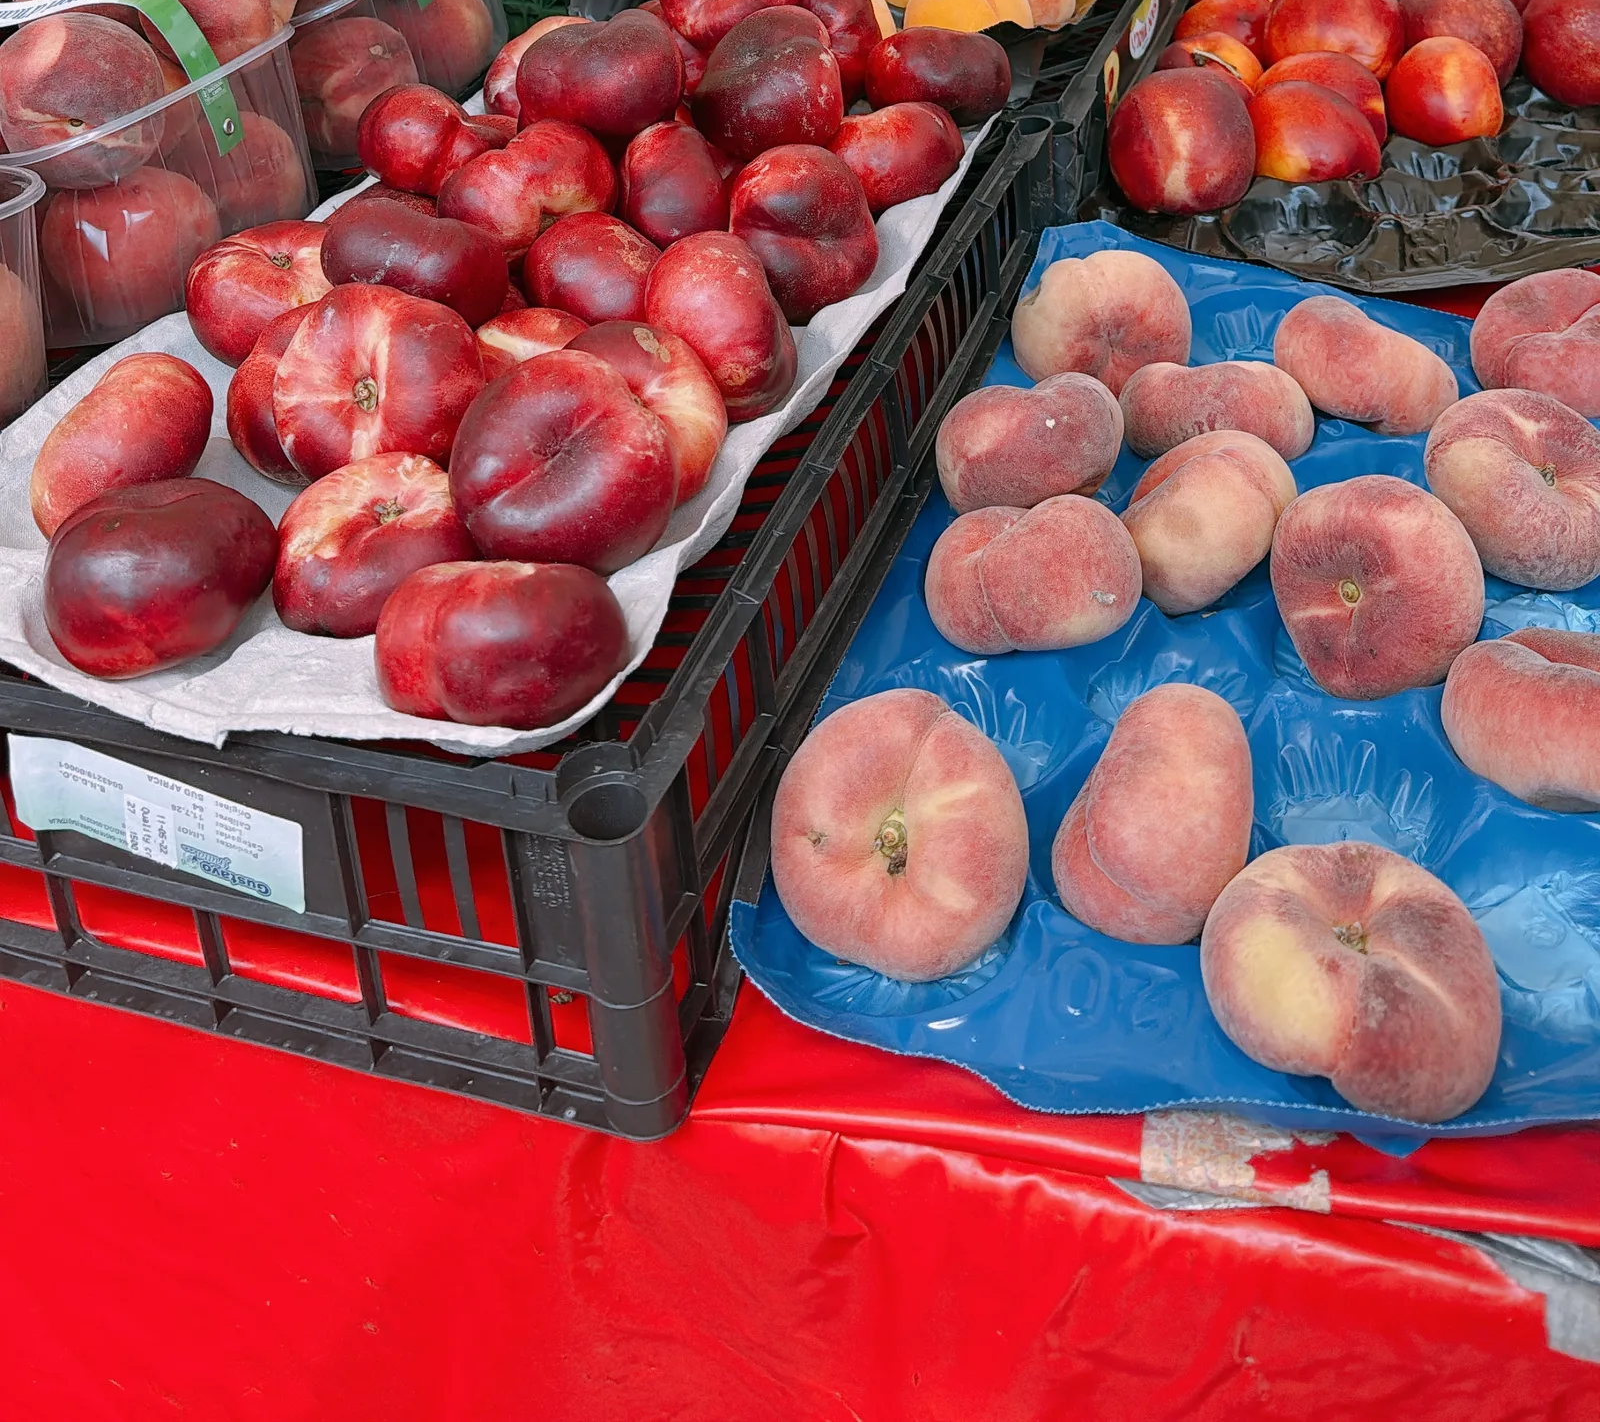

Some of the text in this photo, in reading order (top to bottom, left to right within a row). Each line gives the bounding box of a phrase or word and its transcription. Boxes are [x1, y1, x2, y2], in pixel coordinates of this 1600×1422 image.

[147, 774, 182, 794] AFRICA
[139, 806, 152, 845] Quality
[200, 863, 272, 897] Gustavo
